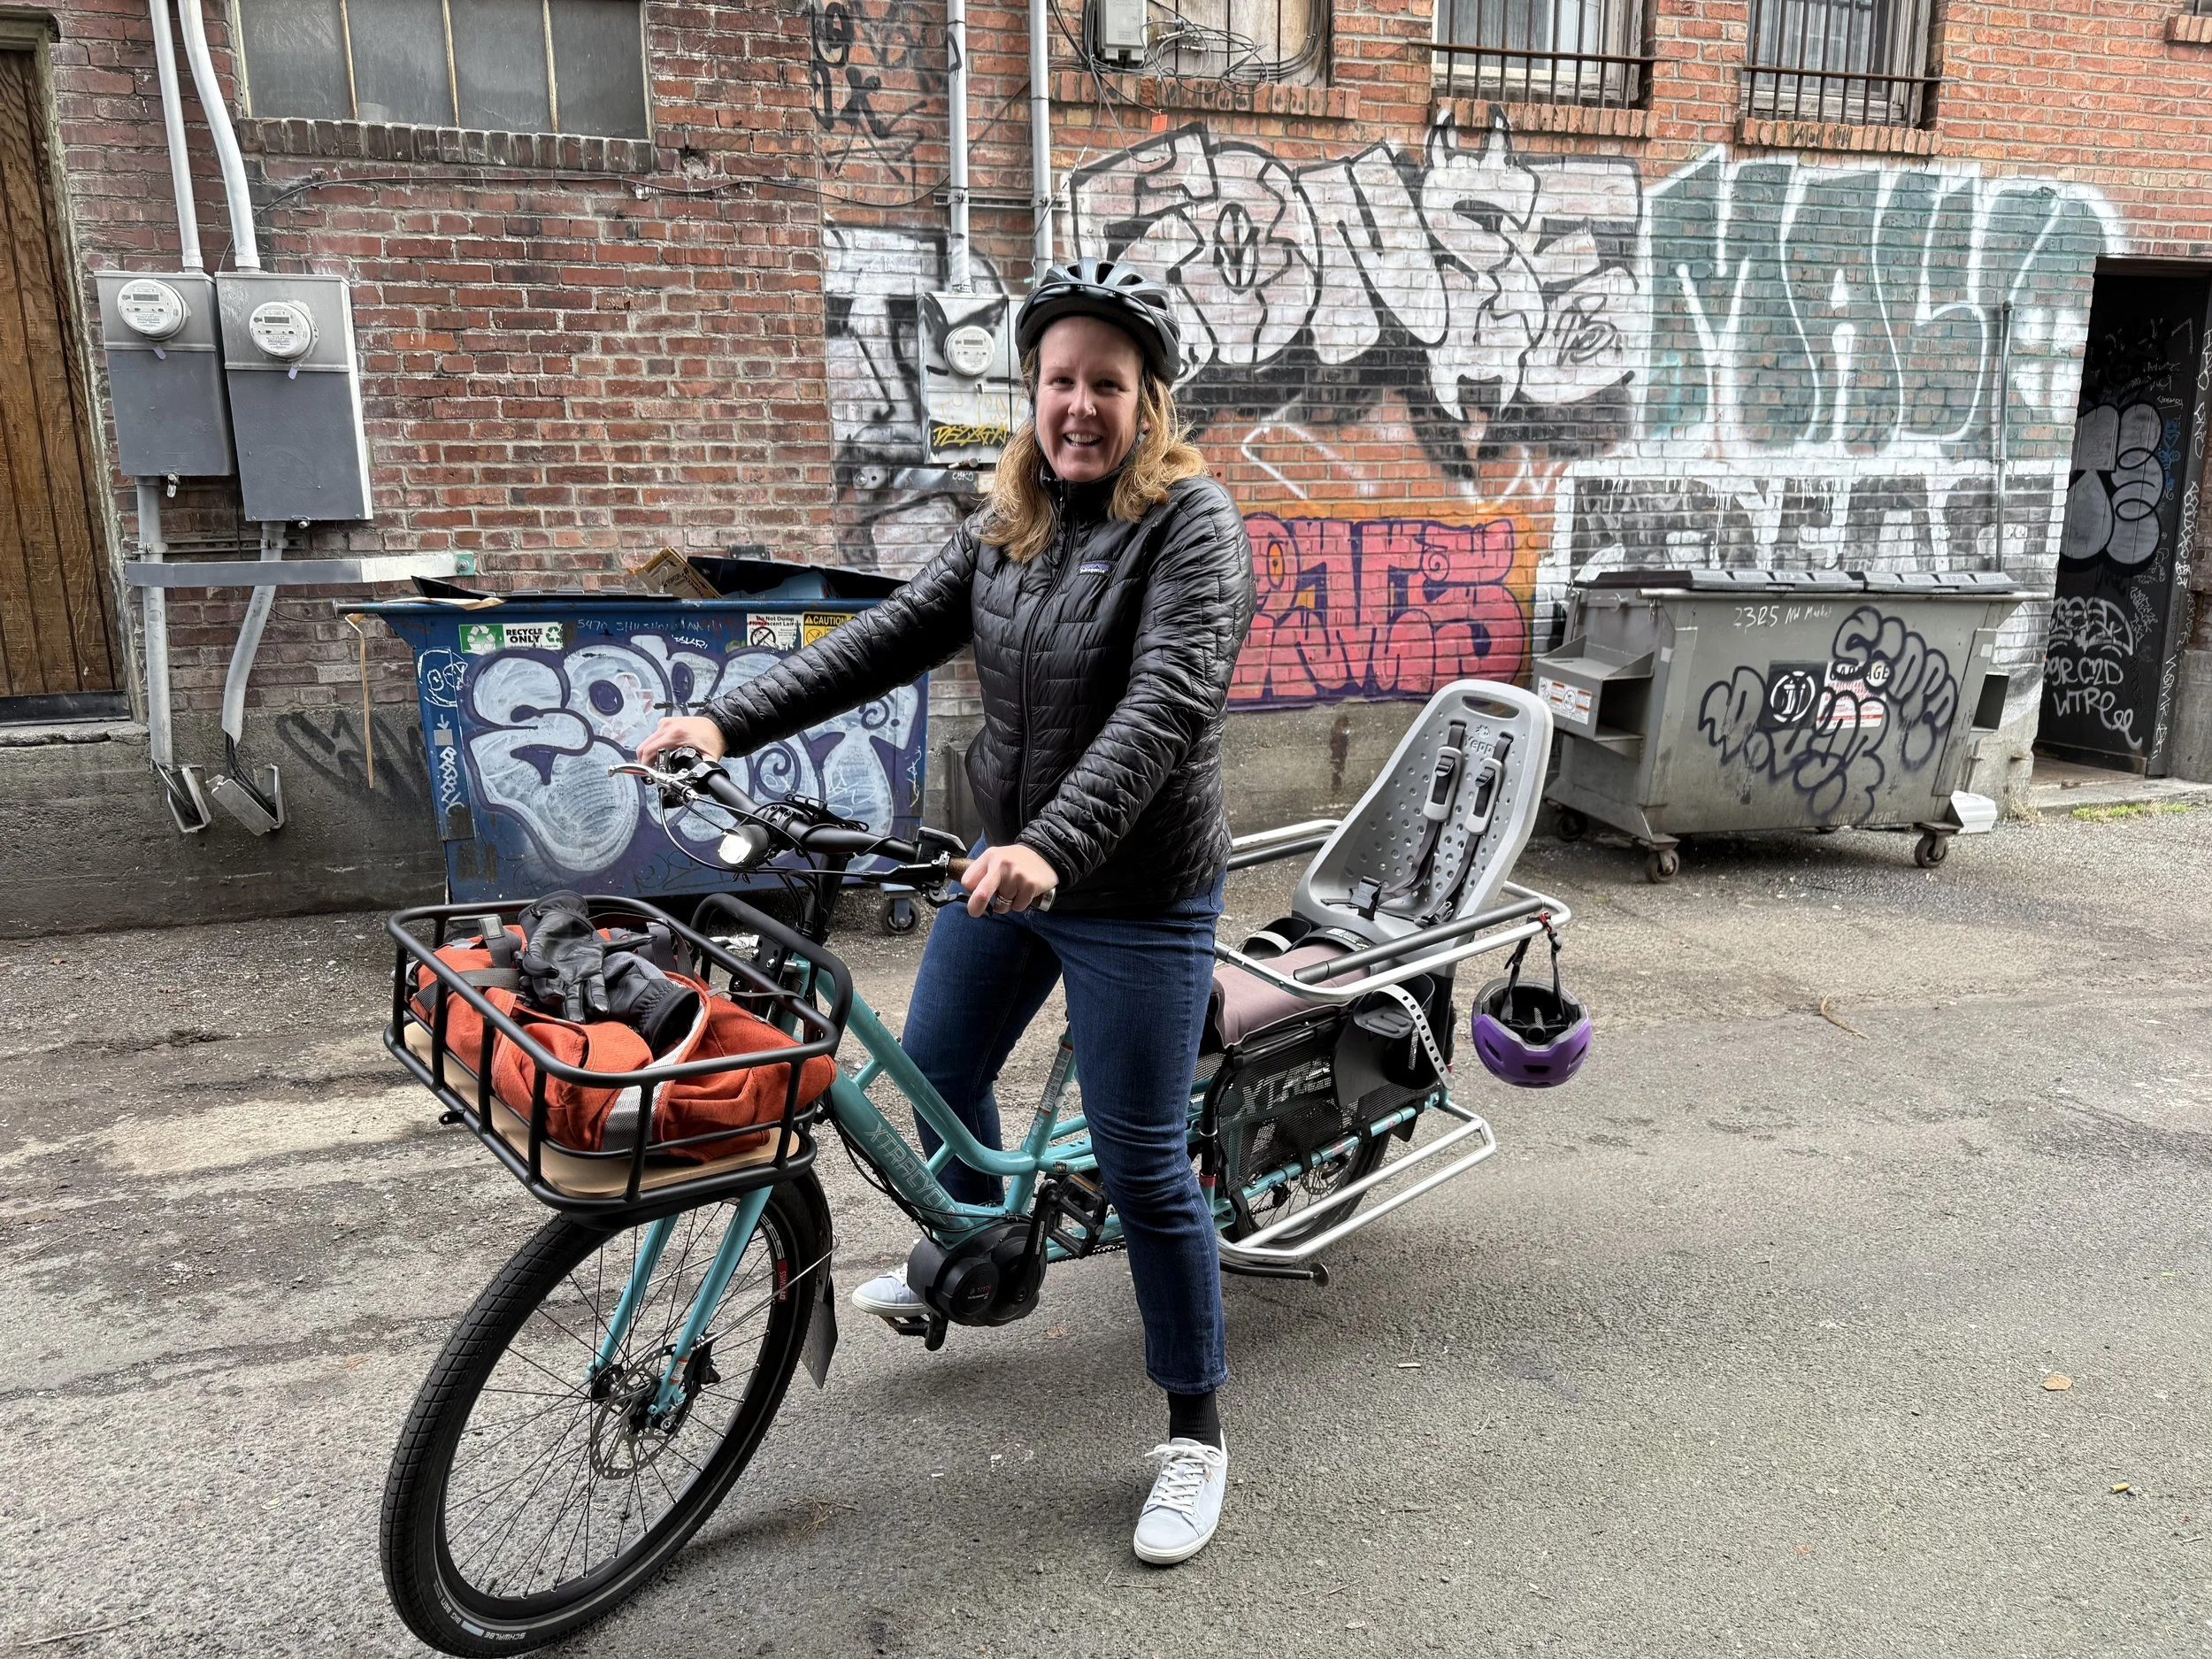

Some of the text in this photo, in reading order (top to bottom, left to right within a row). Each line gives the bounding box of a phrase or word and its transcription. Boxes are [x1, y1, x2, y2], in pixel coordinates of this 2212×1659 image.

[813, 616, 847, 626] CAUTION
[450, 1611, 462, 1624] BIG
[484, 1631, 526, 1640] SCHWALBE
